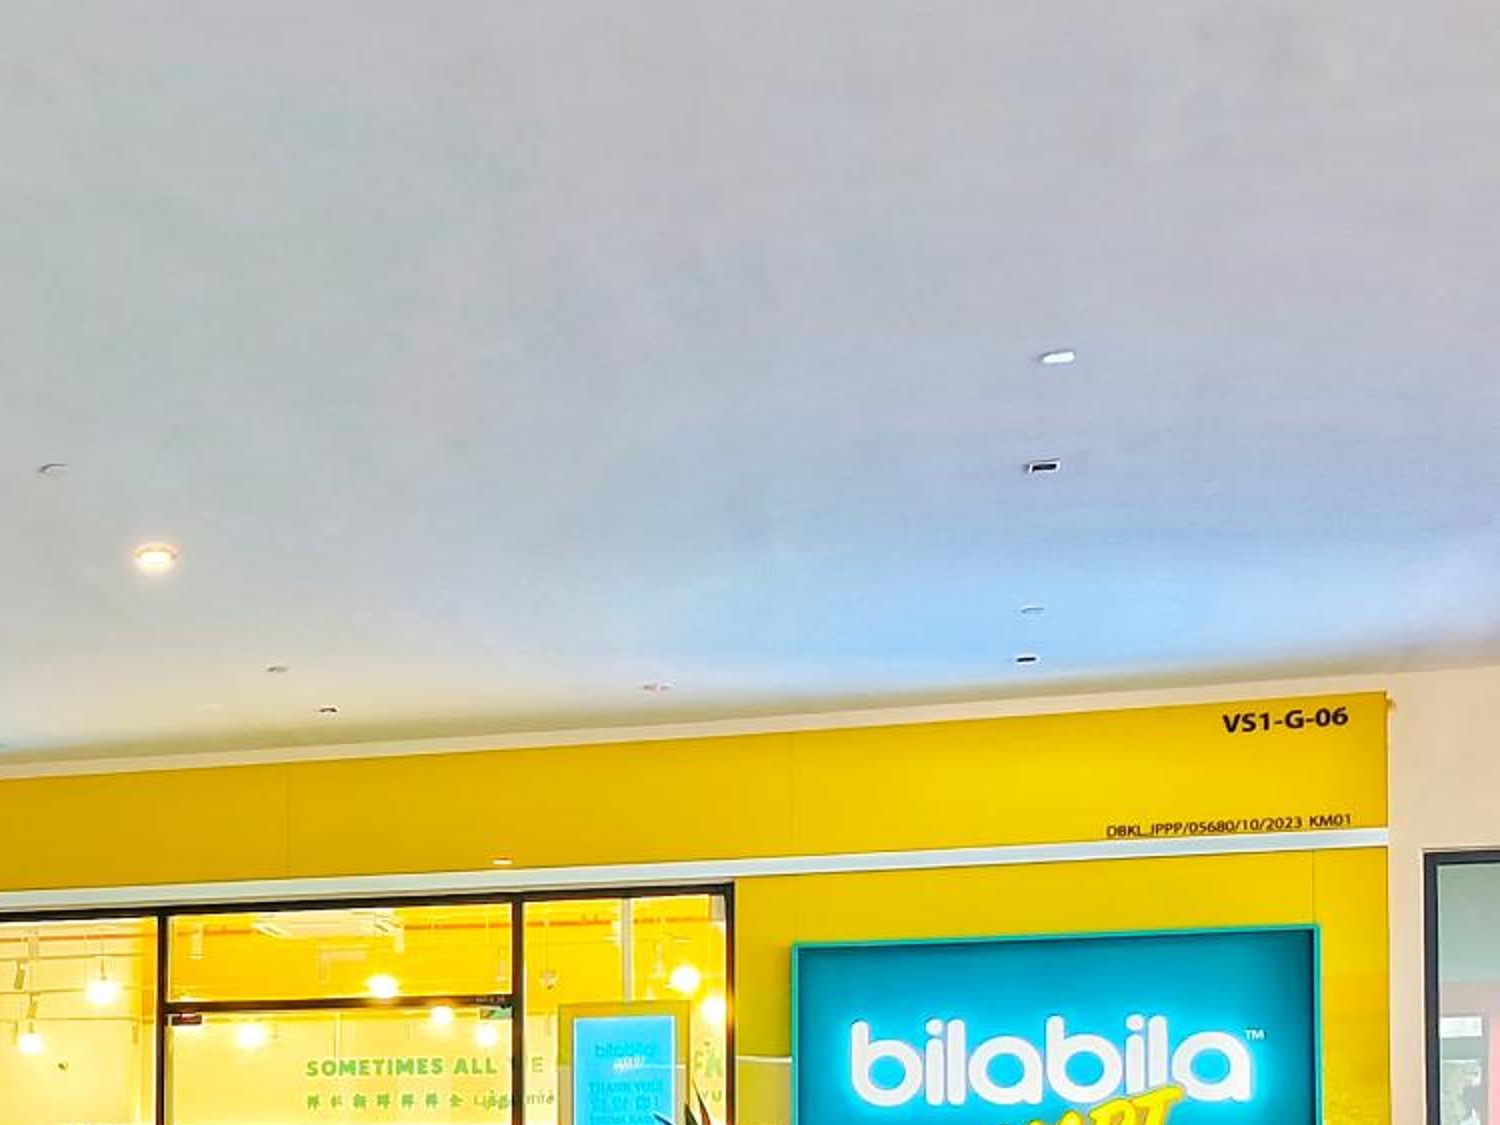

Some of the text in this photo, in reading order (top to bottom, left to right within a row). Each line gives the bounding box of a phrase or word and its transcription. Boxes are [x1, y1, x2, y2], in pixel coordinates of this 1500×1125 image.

[1222, 706, 1349, 734] VS1-G-06
[306, 1057, 443, 1077] SOMETIMES
[453, 1056, 498, 1075] ALL
[850, 1013, 1254, 1108] bilabila
